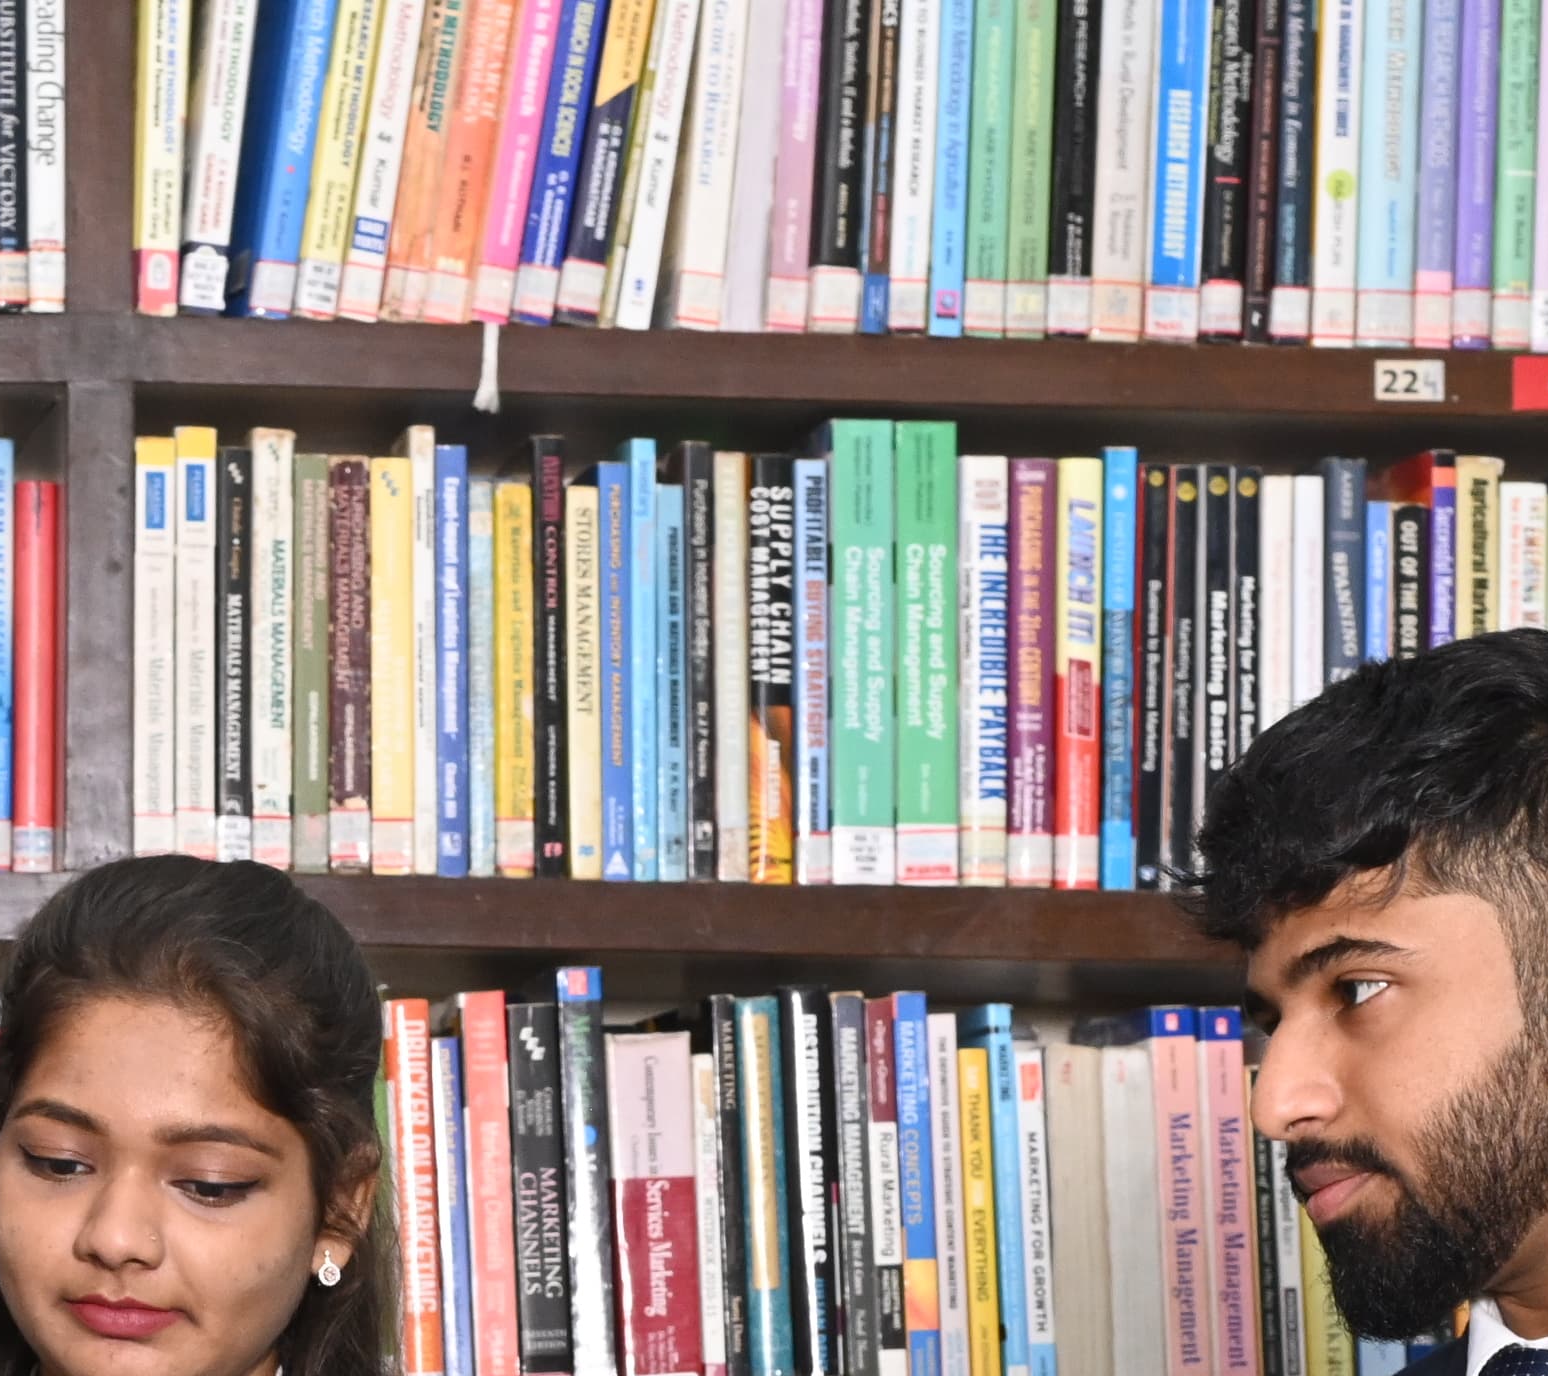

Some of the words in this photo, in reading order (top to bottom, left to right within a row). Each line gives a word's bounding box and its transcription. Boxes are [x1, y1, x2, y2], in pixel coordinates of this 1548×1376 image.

[0, 111, 19, 137] for
[0, 144, 16, 229] VICTORY
[751, 487, 770, 536] COST
[771, 487, 792, 587] SUPPLY
[980, 523, 1006, 560] THE
[751, 548, 770, 682] MANAGEMENT
[926, 544, 948, 625] Sourcing
[771, 603, 792, 684] CHAIN
[930, 633, 948, 666] and
[980, 571, 1006, 695] INCREDIBLE
[1209, 591, 1226, 695] Marketing
[926, 674, 948, 739] Supply
[1210, 701, 1226, 770] Basics
[980, 706, 1006, 799] PAYBACK
[880, 1132, 893, 1173] Rural
[1028, 1132, 1043, 1226] MARKETING
[648, 1179, 671, 1238] Services
[879, 1179, 897, 1257] Marketing
[1031, 1230, 1044, 1260] FOR
[645, 1243, 672, 1316] Marketing
[1033, 1266, 1047, 1332] GROWTH
